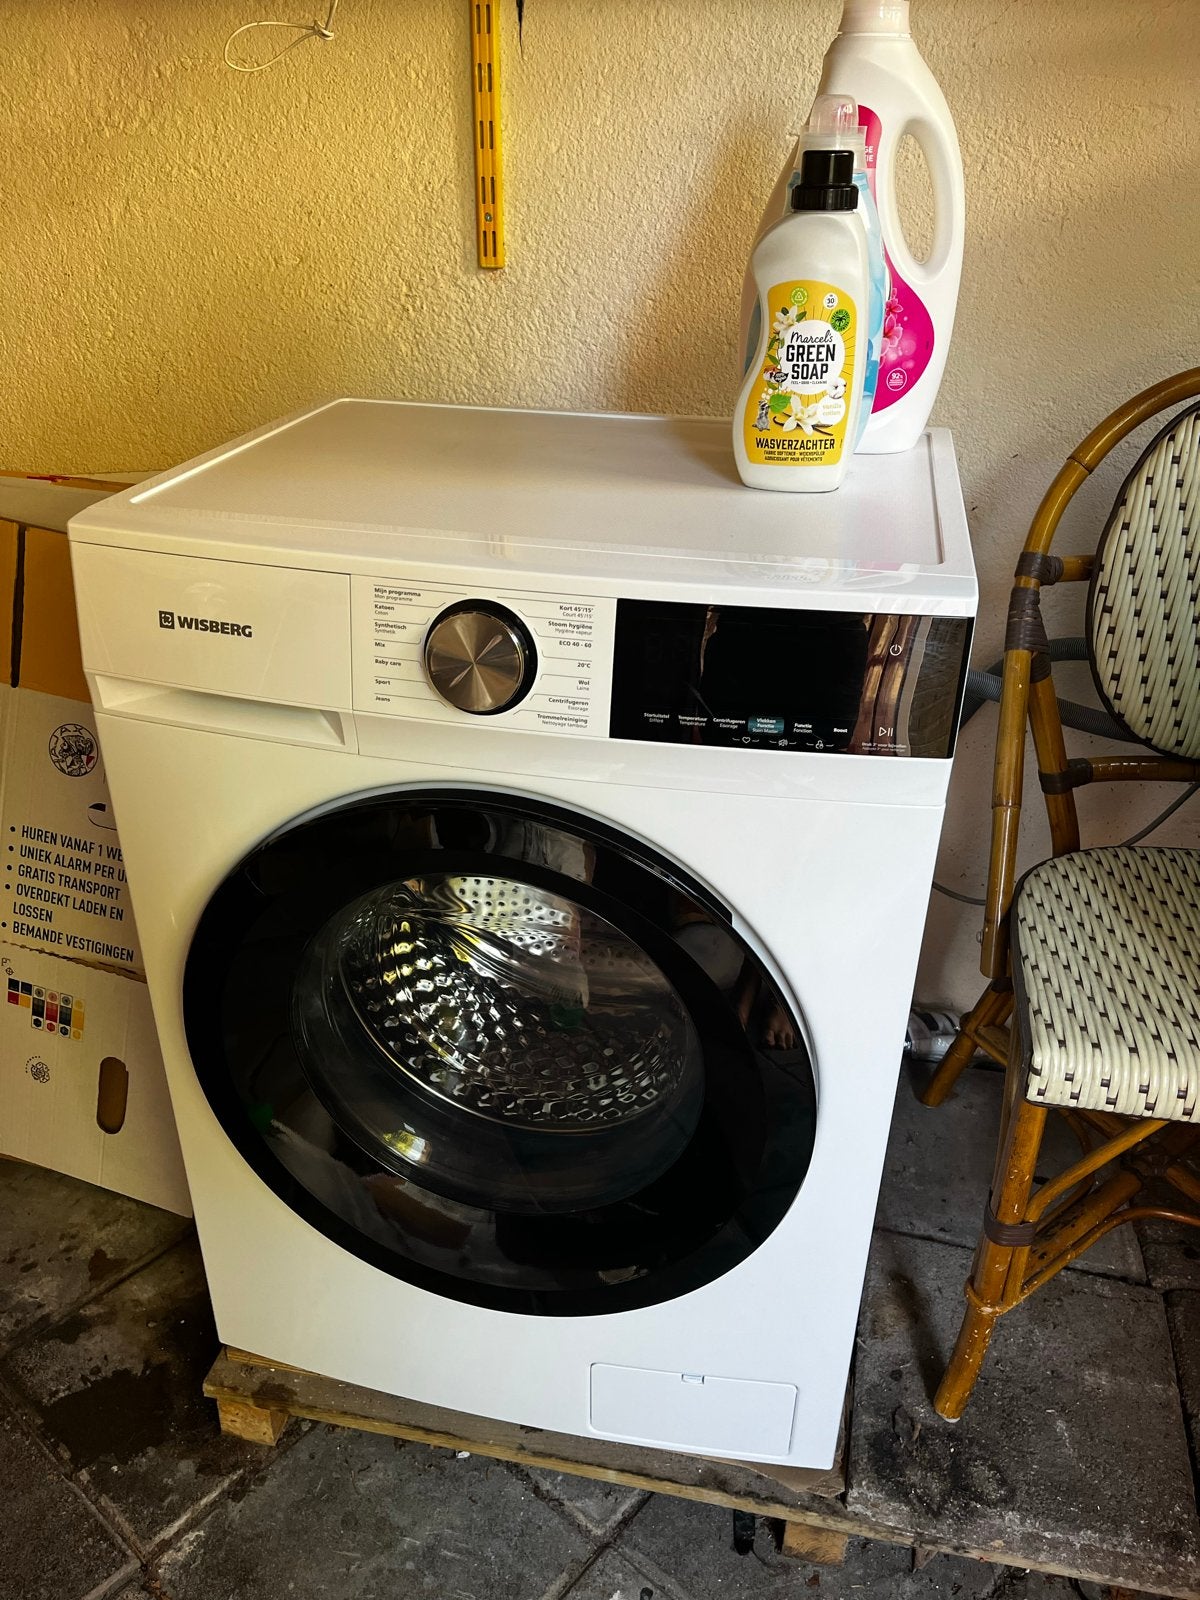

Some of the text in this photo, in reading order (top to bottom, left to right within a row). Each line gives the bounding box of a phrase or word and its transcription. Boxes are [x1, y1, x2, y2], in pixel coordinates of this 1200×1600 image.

[791, 329, 833, 344] Marcel's
[786, 344, 836, 362] GREEN
[791, 363, 829, 380] SOAP
[755, 437, 835, 450] WASVERZACHTER
[388, 589, 421, 597] programma
[177, 615, 252, 638] WISBERG
[374, 621, 407, 630] Synthetisch
[548, 620, 567, 628] Stoom
[548, 697, 589, 706] Centrifugeren
[537, 713, 588, 724] Trommelreiniging
[21, 825, 58, 846] HUREN
[60, 835, 95, 854] VANAF
[98, 845, 102, 857] 1
[20, 845, 52, 865] UNIEK
[54, 853, 91, 874] ALARM
[94, 863, 115, 880] PER
[18, 864, 121, 901] GRATIS TRANSPORT
[16, 883, 124, 921] OVERDEKT LADEN EN
[13, 902, 53, 923] LOSSEN
[13, 921, 134, 962] BEMANDE VESTIGINGEN
